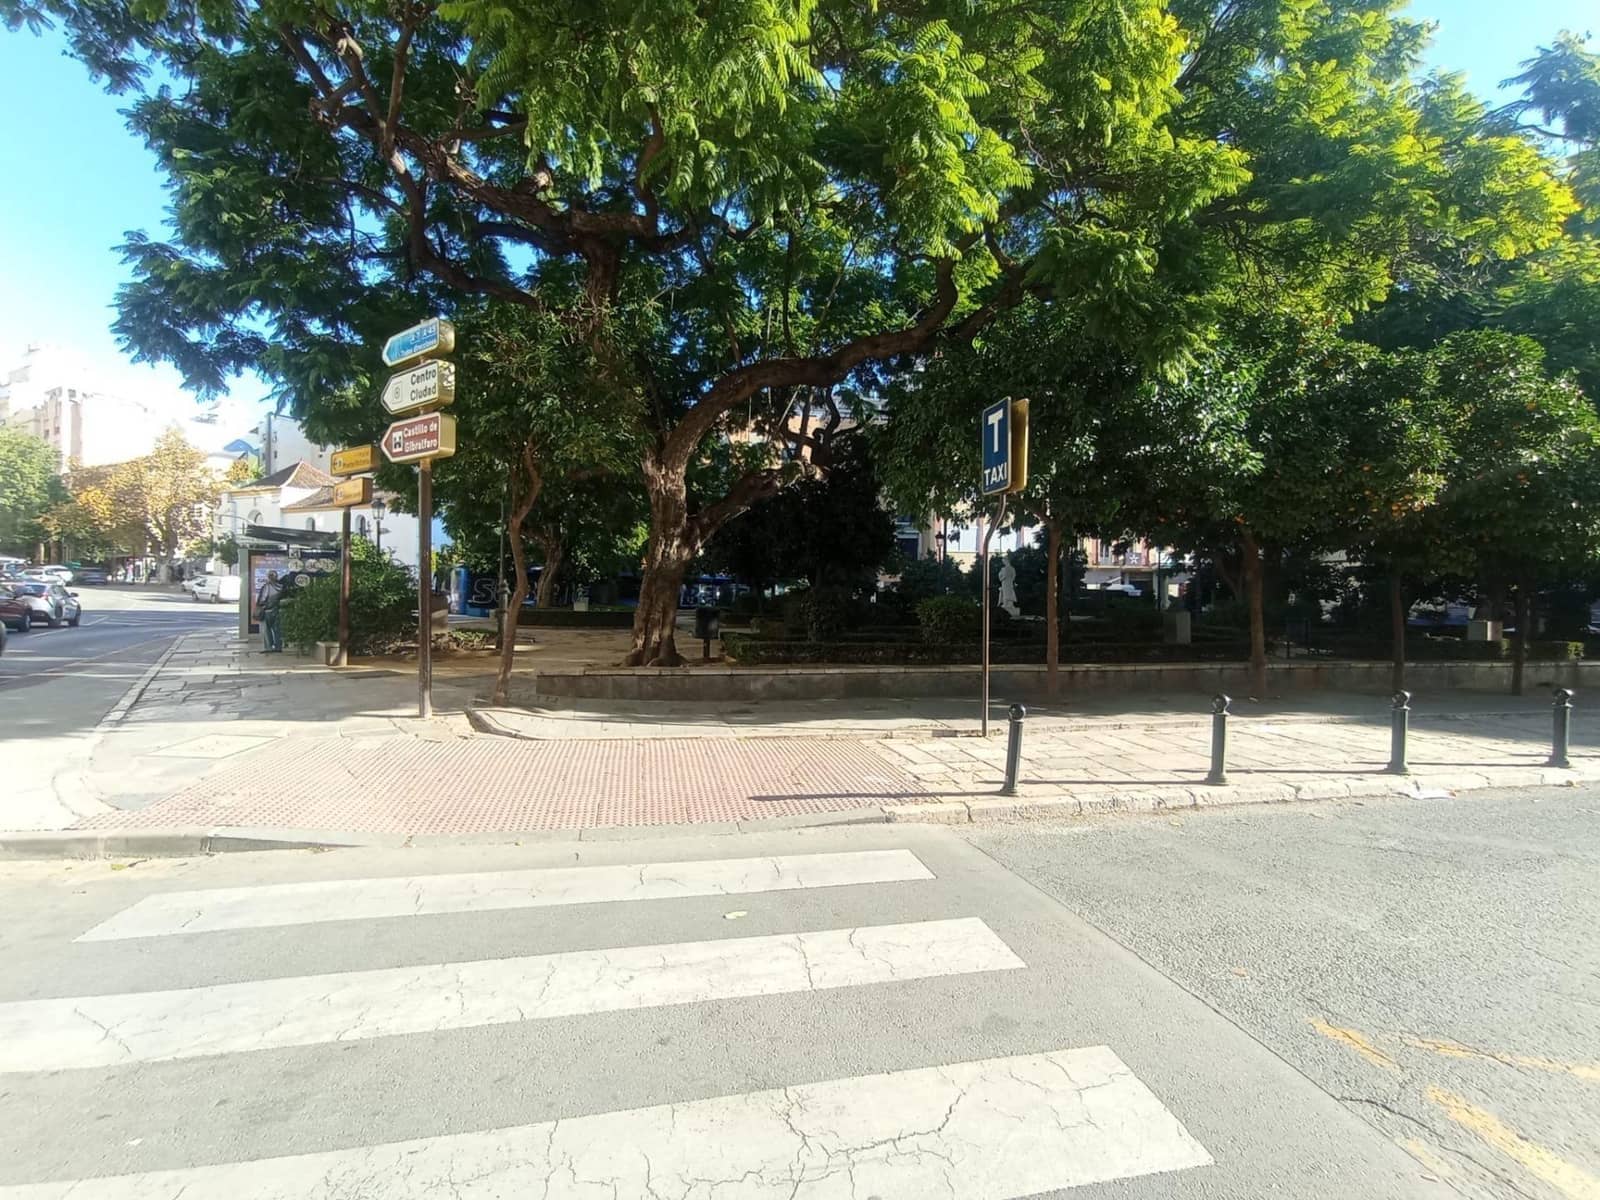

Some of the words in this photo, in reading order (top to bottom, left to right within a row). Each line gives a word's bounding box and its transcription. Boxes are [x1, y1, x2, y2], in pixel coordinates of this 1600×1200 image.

[410, 367, 437, 386] Centro
[410, 384, 437, 402] Ciudad
[403, 424, 429, 439] Castillo
[429, 422, 438, 433] de
[987, 409, 1004, 453] T
[404, 438, 438, 454] Gibralfaro
[984, 462, 1008, 486] TAXI
